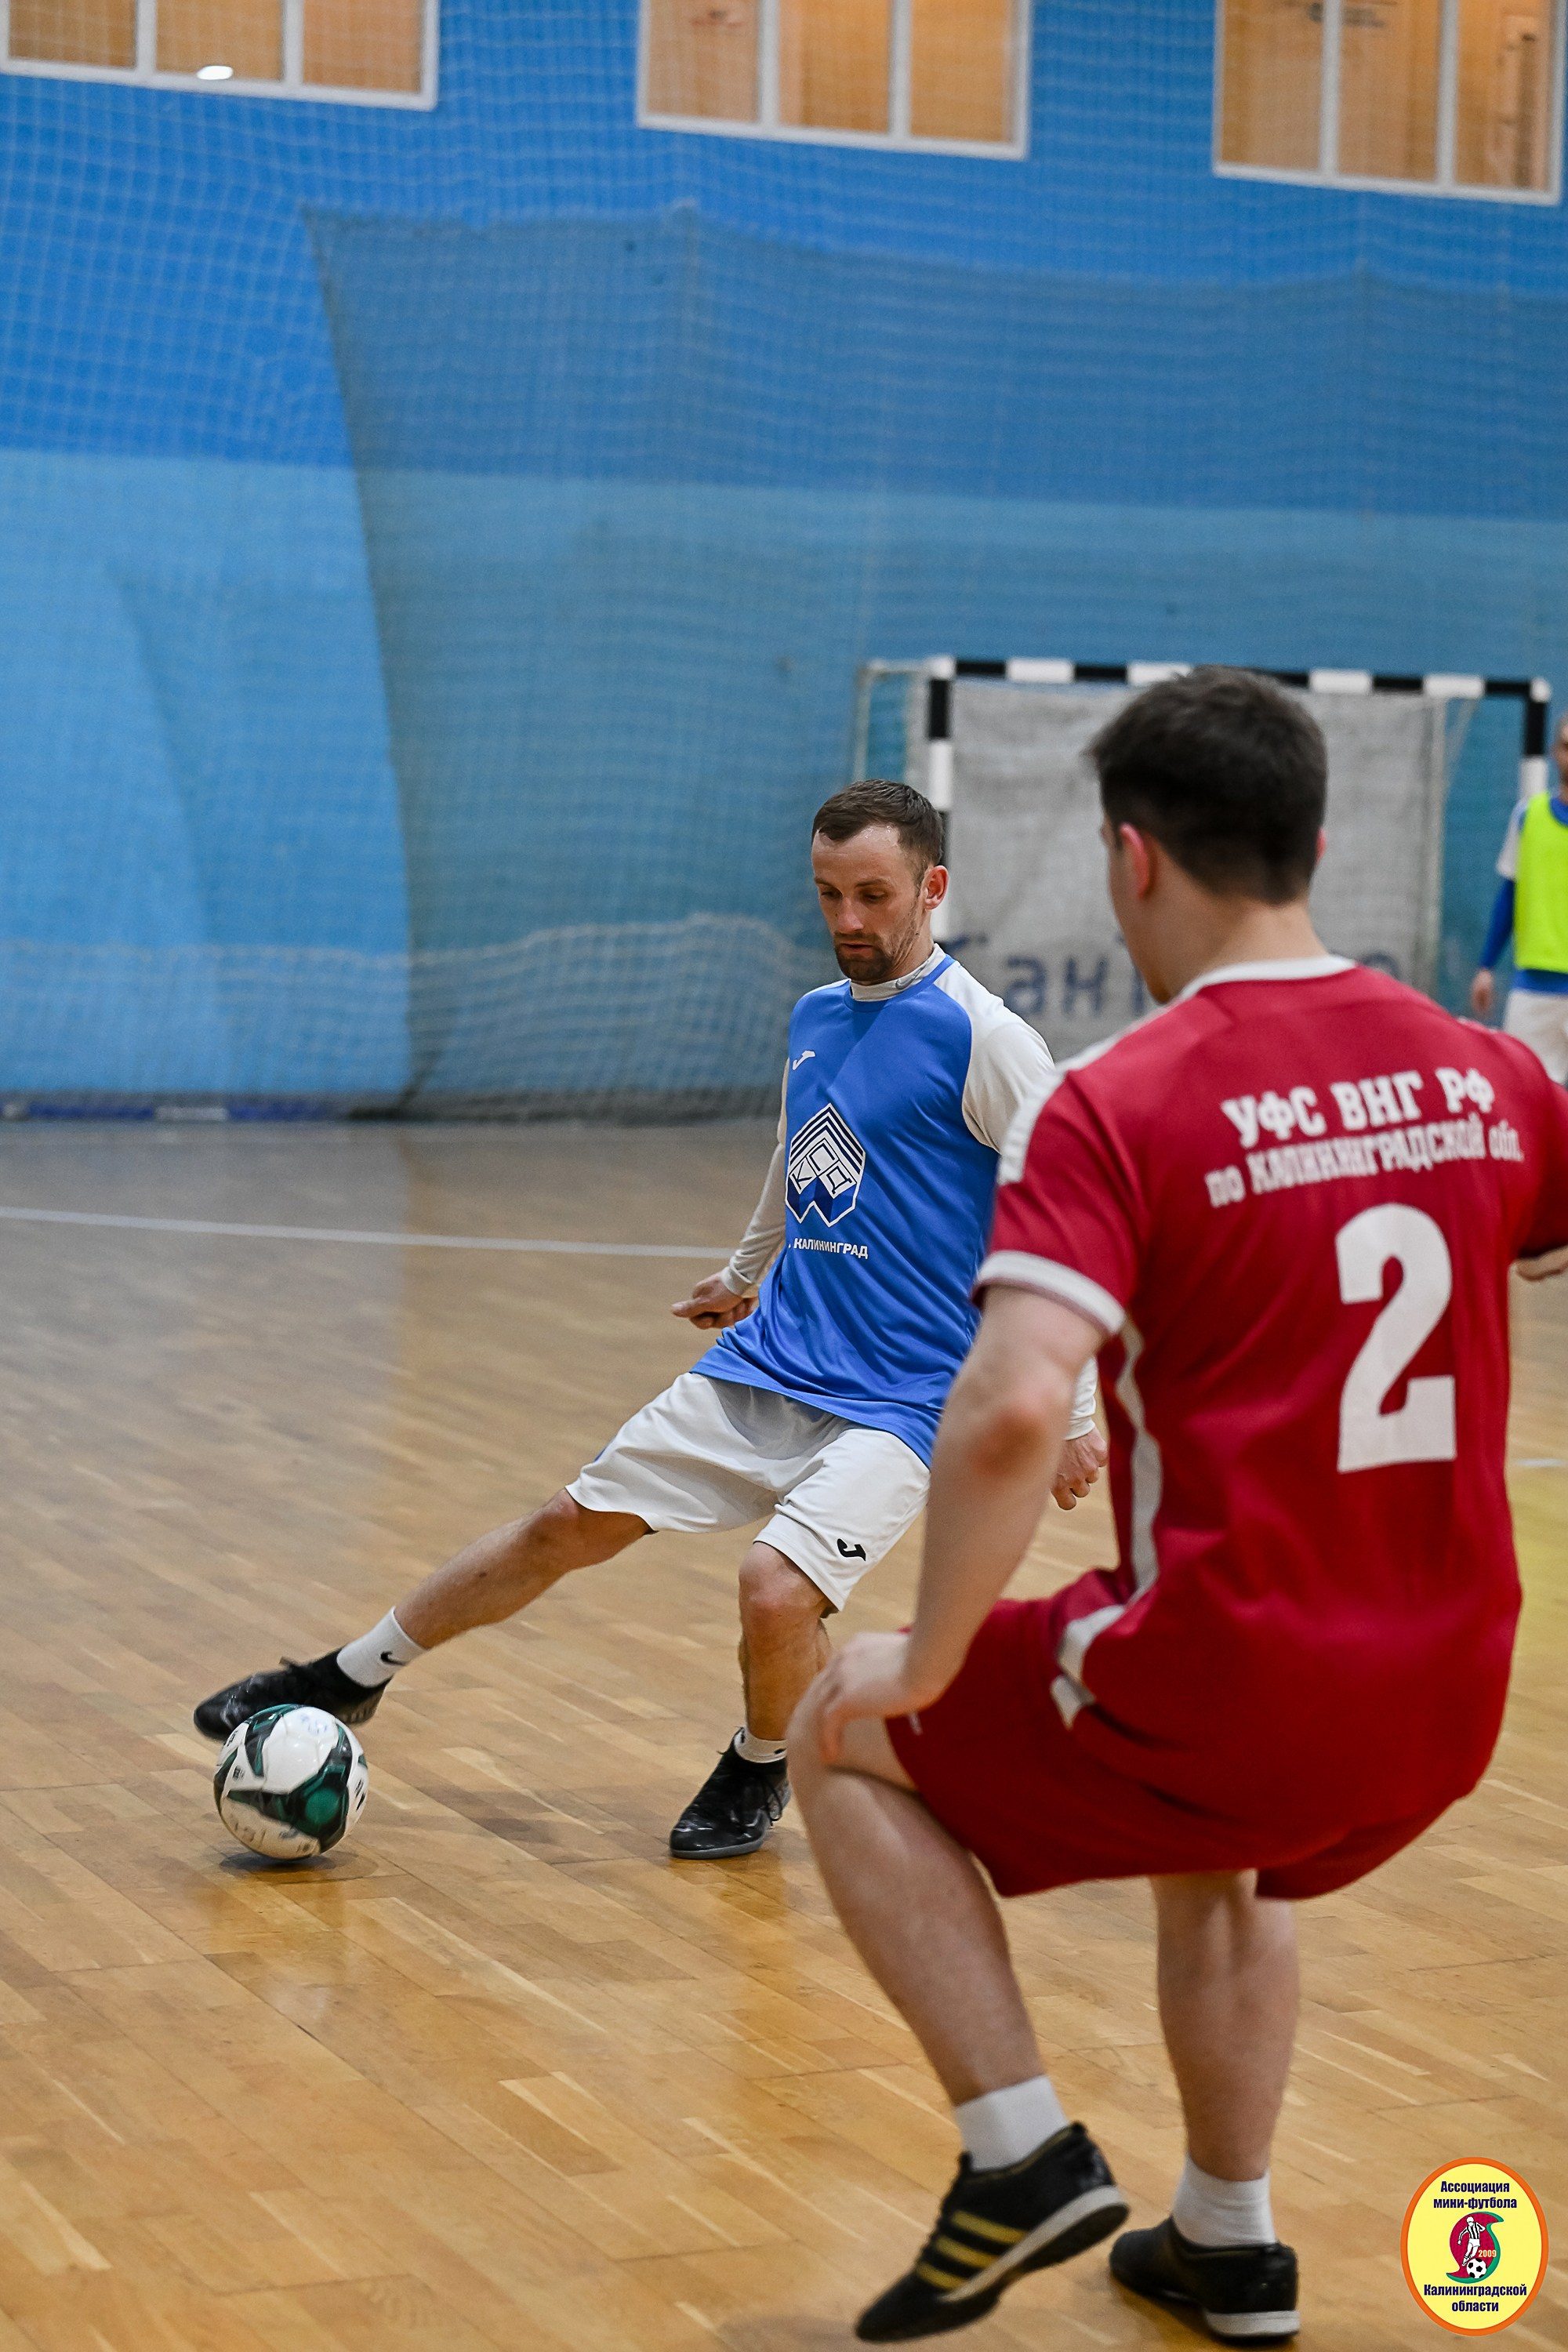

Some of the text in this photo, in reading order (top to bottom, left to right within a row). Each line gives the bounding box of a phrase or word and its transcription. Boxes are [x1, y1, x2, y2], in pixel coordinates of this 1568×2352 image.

[1222, 1067, 1495, 1148] УФС ВНГ РФ
[793, 1238, 869, 1260] КАЛИНИНГРАД
[1335, 1203, 1456, 1473] 2
